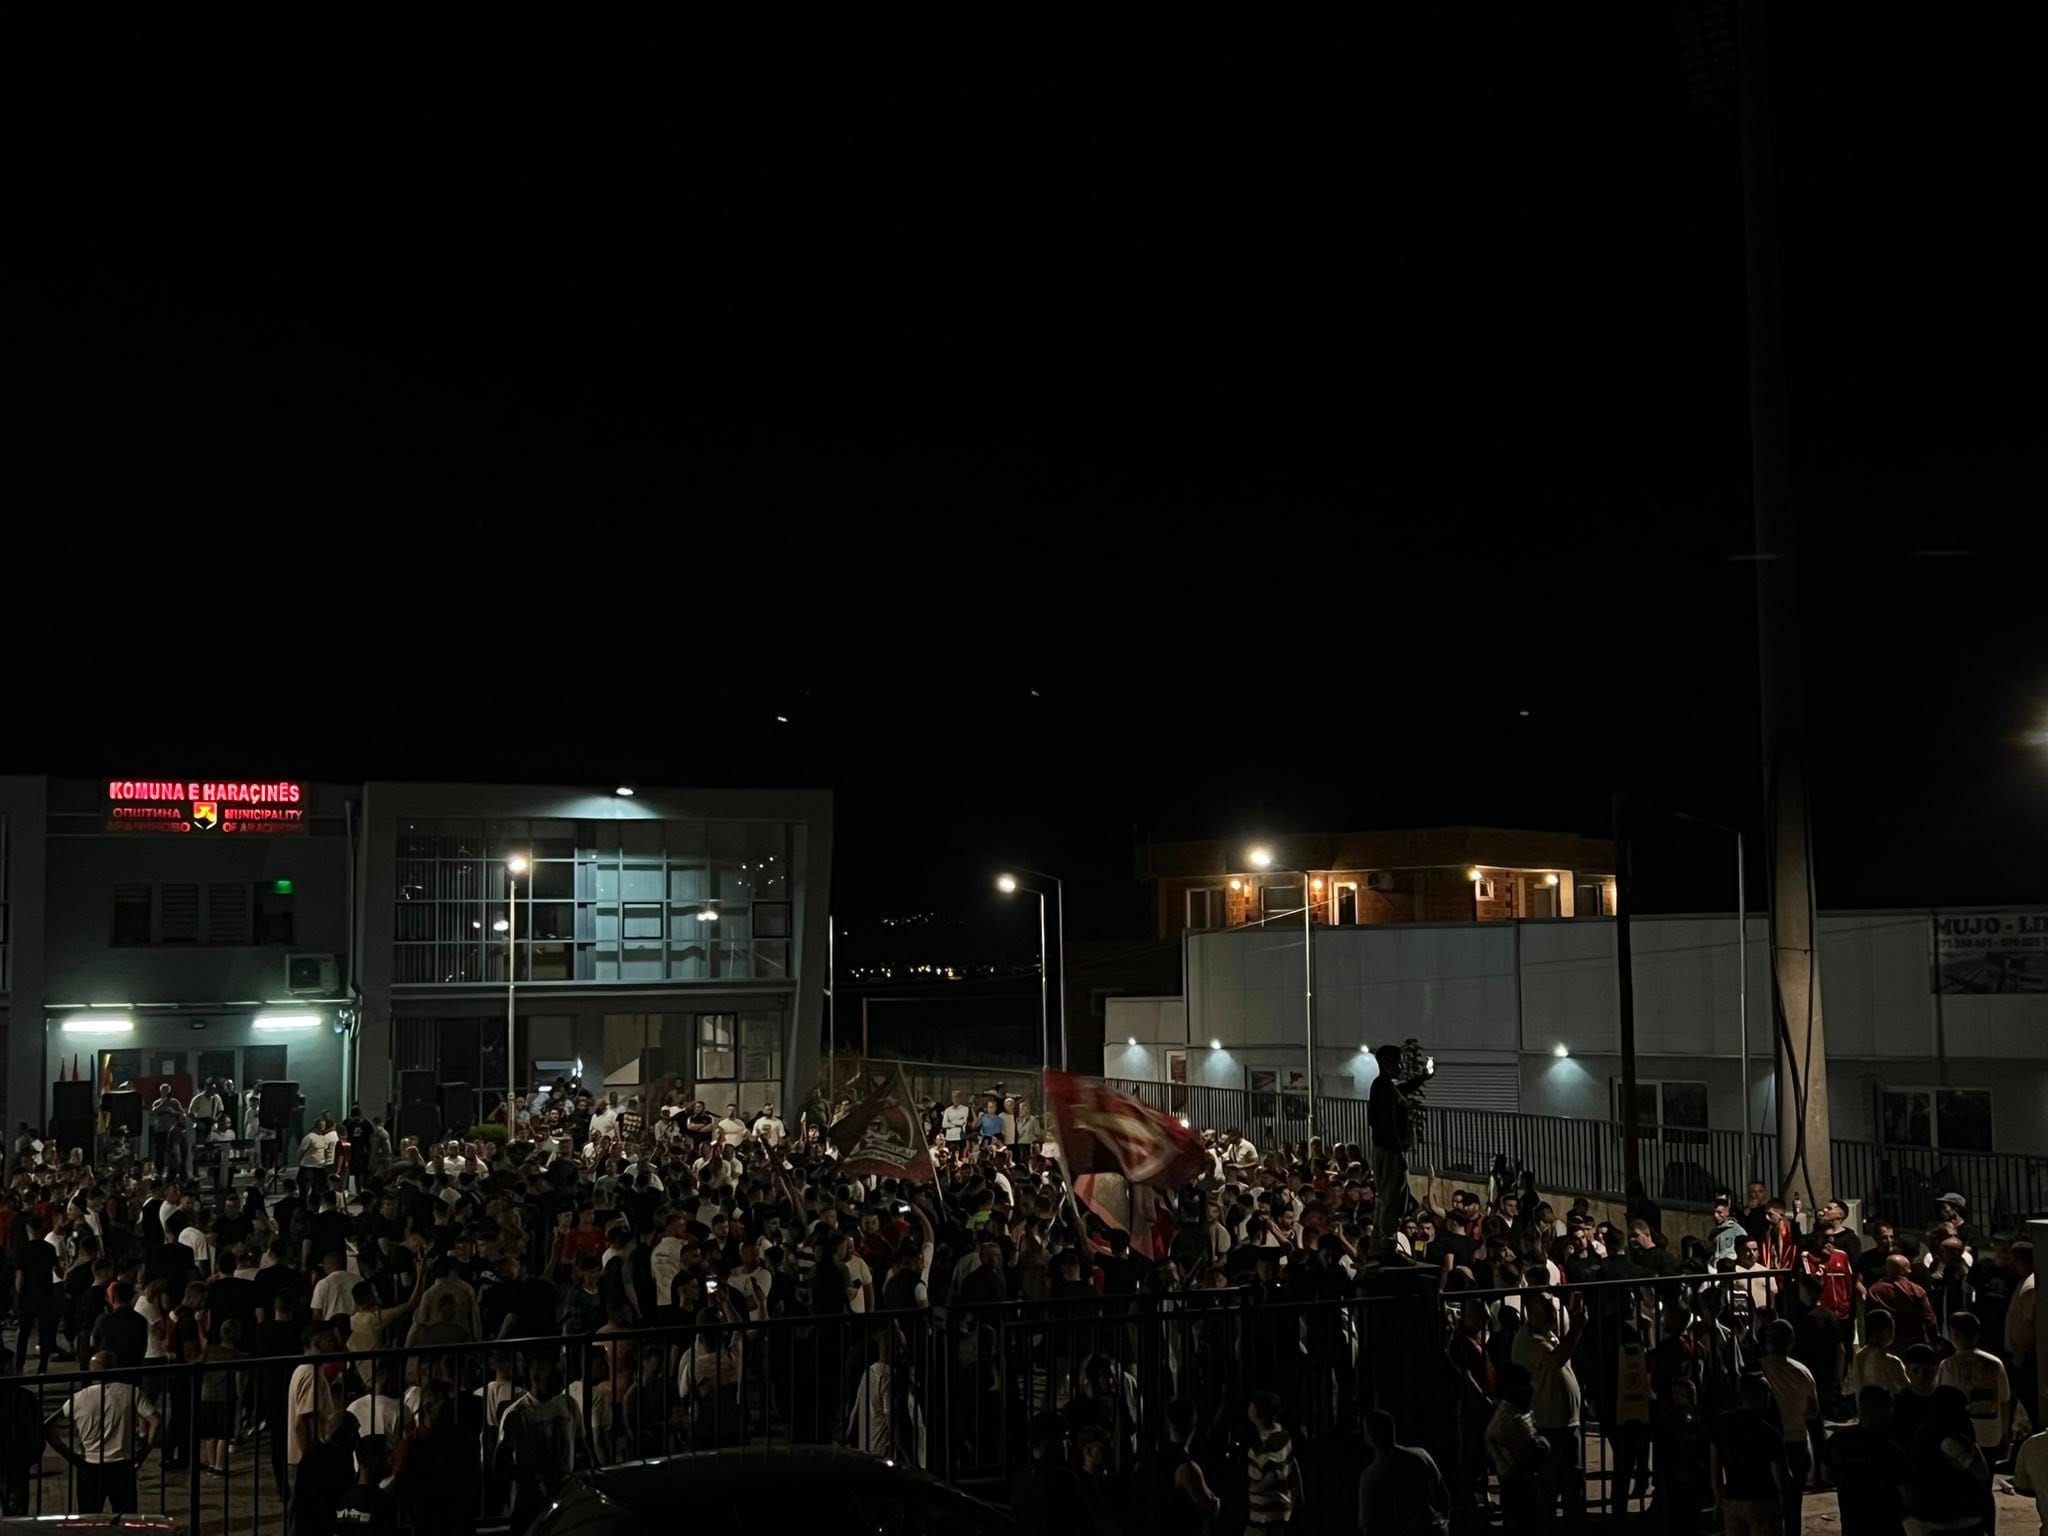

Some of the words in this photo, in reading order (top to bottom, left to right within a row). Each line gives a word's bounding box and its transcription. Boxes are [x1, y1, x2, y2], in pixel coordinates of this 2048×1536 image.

[109, 781, 185, 801] KOMUNA
[188, 783, 200, 802] E
[203, 782, 300, 805] HARAÇINËS
[224, 809, 303, 821] MUNICIPALITY
[1937, 917, 2000, 934] MUJO
